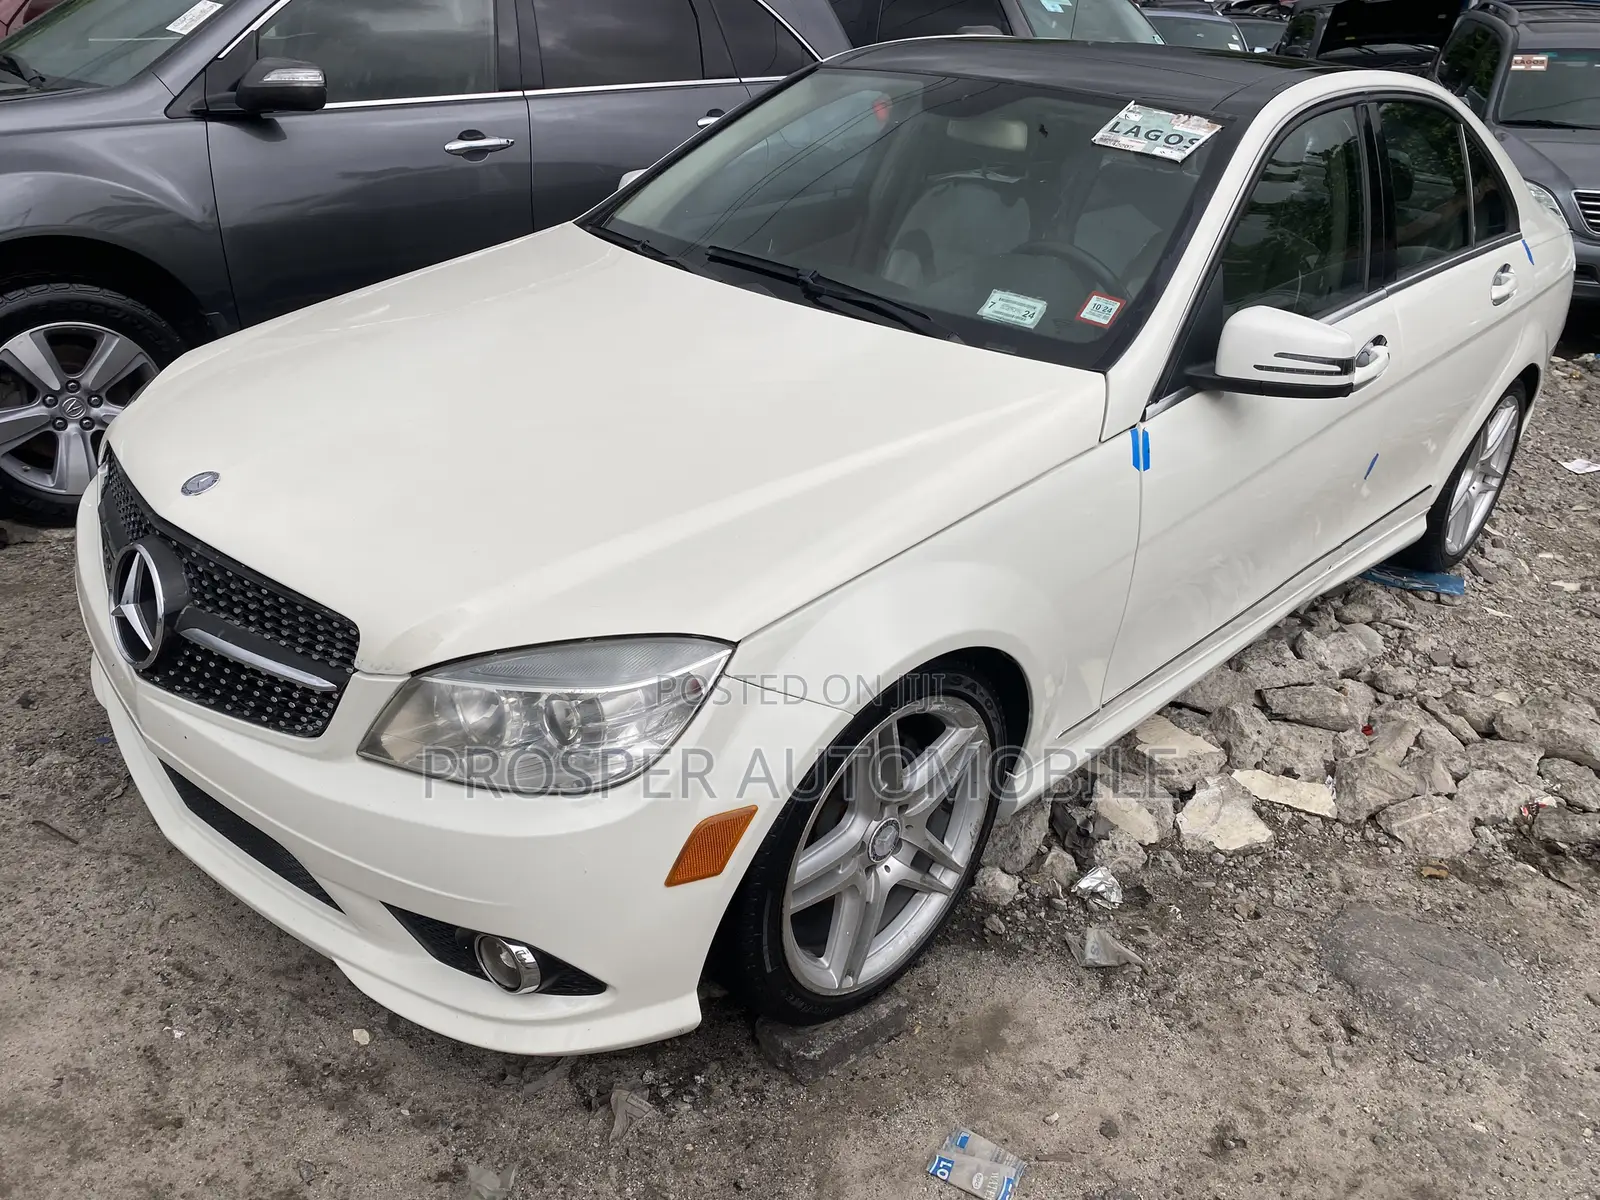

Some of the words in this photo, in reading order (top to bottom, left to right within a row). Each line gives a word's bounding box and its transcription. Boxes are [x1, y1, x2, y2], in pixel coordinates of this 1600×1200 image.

[1109, 122, 1200, 149] LAGOS
[1092, 302, 1102, 311] 10
[1102, 305, 1113, 314] 24
[1022, 310, 1036, 320] 24
